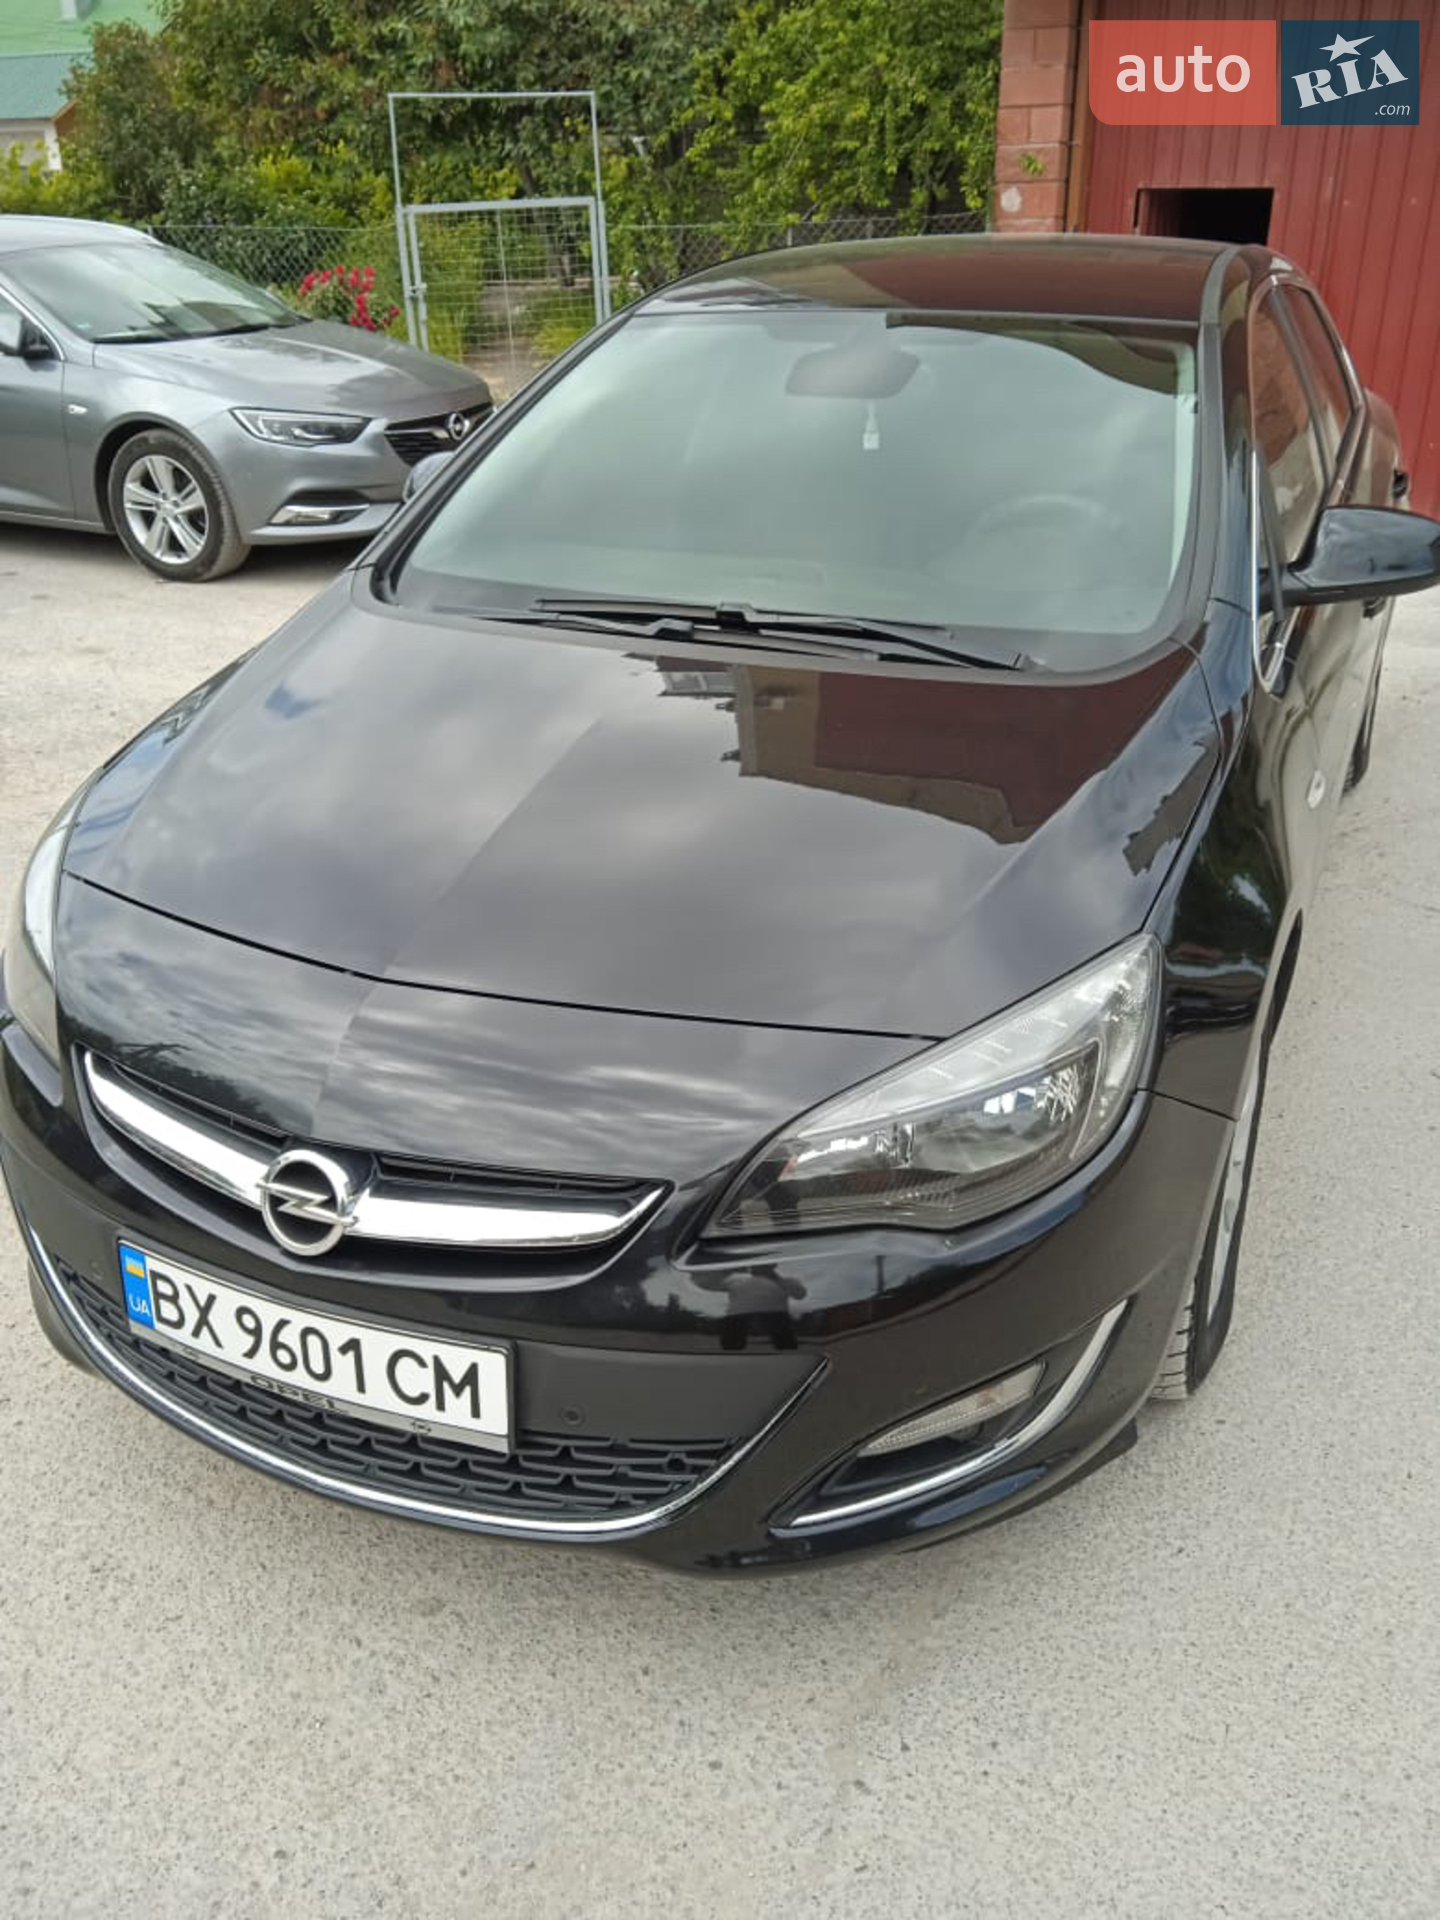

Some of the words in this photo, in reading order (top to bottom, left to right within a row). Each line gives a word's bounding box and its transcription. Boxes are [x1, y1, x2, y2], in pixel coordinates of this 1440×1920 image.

[128, 1293, 152, 1318] UA
[149, 1268, 224, 1350] BX
[234, 1305, 367, 1395] 9601
[386, 1348, 481, 1420] CM
